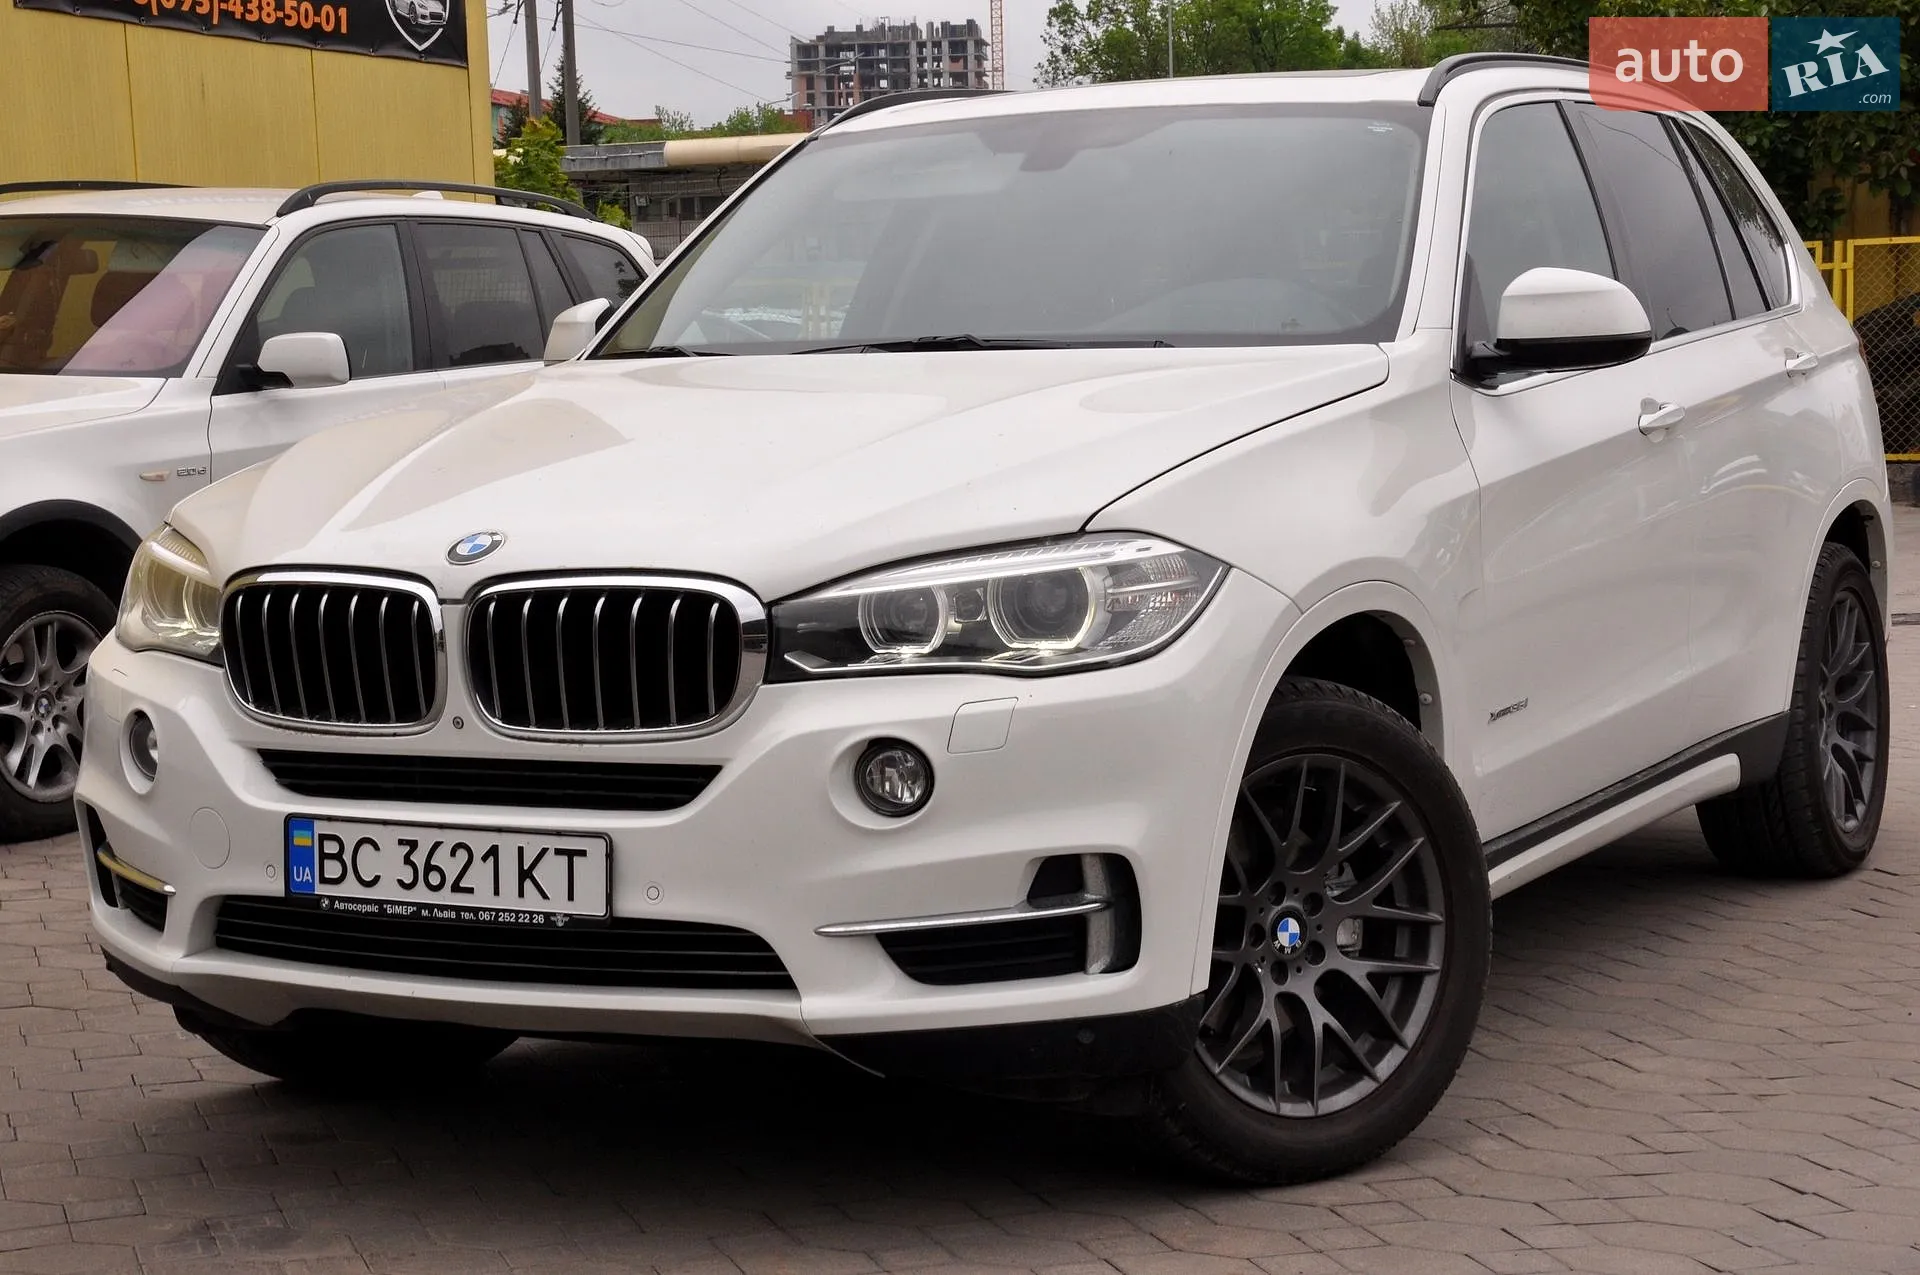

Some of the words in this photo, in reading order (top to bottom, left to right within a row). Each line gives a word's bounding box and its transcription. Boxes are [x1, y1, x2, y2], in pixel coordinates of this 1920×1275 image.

[293, 866, 313, 884] UA
[318, 833, 382, 888] BC
[396, 838, 501, 896] 3621
[517, 845, 588, 902] KT
[333, 900, 379, 913] Автосервіс
[421, 909, 431, 917] м.
[433, 908, 456, 919] Львів
[460, 911, 477, 920] тел.
[478, 911, 496, 921] 067
[498, 912, 516, 922] 252
[518, 913, 530, 923] 22
